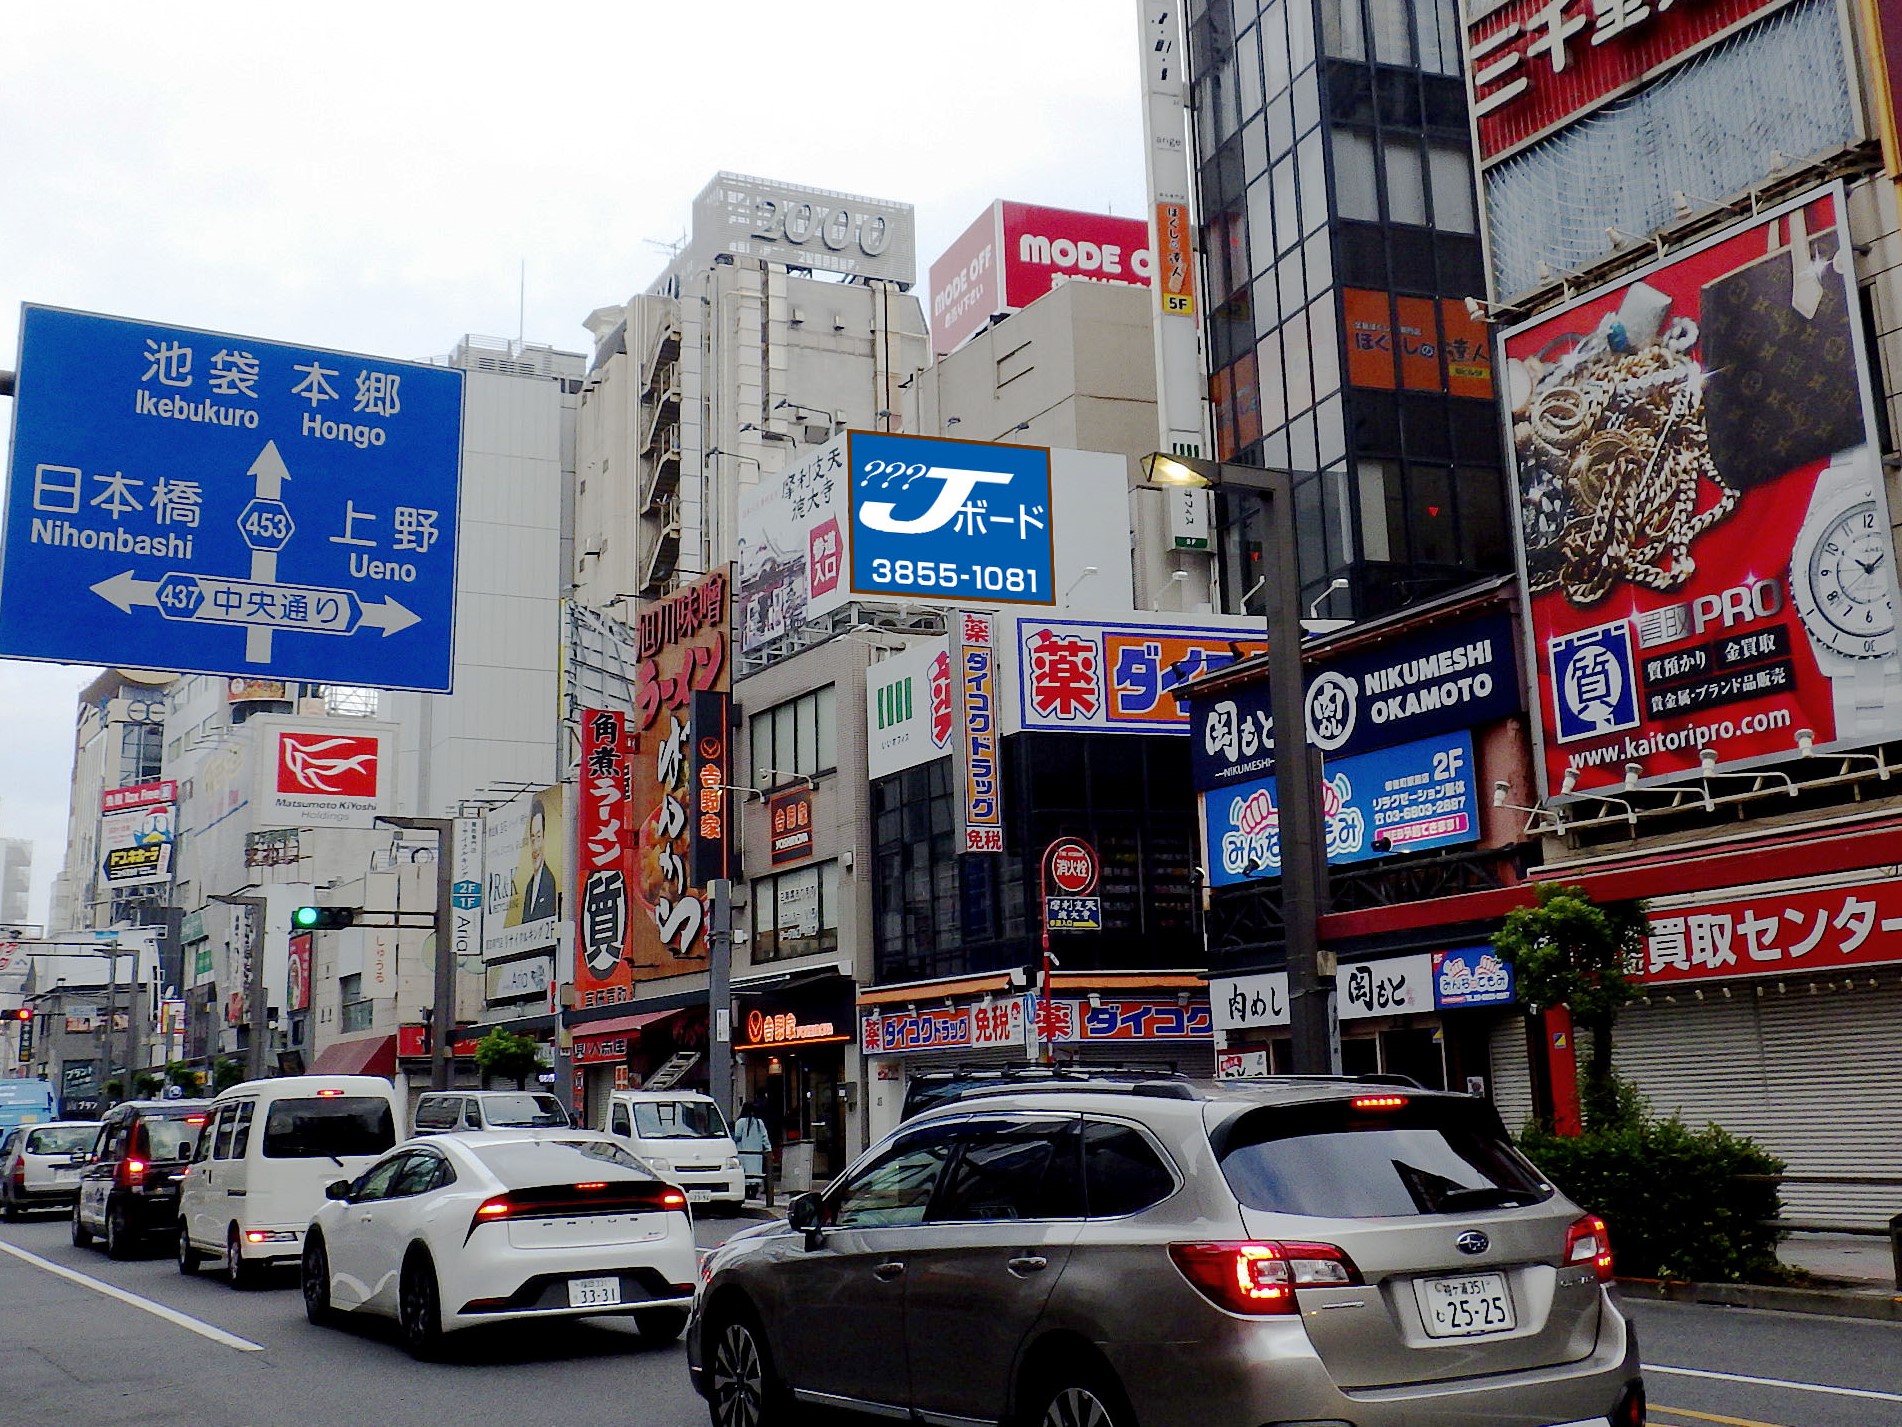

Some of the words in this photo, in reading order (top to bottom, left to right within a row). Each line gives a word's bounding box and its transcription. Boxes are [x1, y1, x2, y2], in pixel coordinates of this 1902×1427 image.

[751, 200, 894, 256] 2000
[1020, 234, 1121, 272] MODE
[935, 268, 968, 317] MODE
[970, 244, 992, 282] OFF
[1169, 297, 1187, 310] 5F
[141, 338, 260, 399] 池袋
[291, 361, 401, 418] 本郷
[135, 389, 260, 429] Ikebukuro
[302, 413, 386, 449] Hongo
[33, 463, 203, 528] 日本橋
[30, 518, 193, 560] Nihonbashi
[245, 512, 287, 540] 453
[329, 500, 439, 553] 上野
[349, 552, 417, 583] Ueno
[813, 556, 837, 588] 入口
[872, 558, 1038, 593] 3855-1081
[160, 584, 199, 610] 437
[213, 586, 341, 624] 中央通り
[638, 574, 726, 660] 旭川味噌
[964, 614, 990, 643] 薬
[1030, 632, 1098, 716] 薬
[1365, 640, 1493, 697] NIKUMESHI
[1647, 649, 1707, 682] 質預かり
[1724, 632, 1776, 664] 金買取
[636, 631, 724, 731] ラーメン
[1371, 673, 1494, 724] OKAMOTO
[1571, 647, 1623, 726] 質
[965, 651, 995, 819] ダイコクドラッグ
[1205, 701, 1275, 762] 岡もと
[1569, 707, 1791, 770] www.kaitoripro.com
[1433, 747, 1463, 780] 2F
[275, 798, 337, 810] Matsumoto
[339, 801, 377, 811] KiYoshi
[588, 711, 623, 866] 角煮ラーメン
[700, 763, 722, 839] 吉野家
[775, 800, 808, 833] 吉野家
[966, 829, 1002, 851] 免税
[459, 883, 476, 894] 2F
[1056, 859, 1088, 877] 消火栓
[459, 897, 476, 909] 1F
[583, 871, 627, 969] 質
[1622, 896, 1902, 976] 買取センター
[1228, 982, 1283, 1023] 肉めし
[1350, 965, 1406, 1012] 岡もと
[763, 1012, 797, 1042] 吉野家
[865, 1017, 879, 1049] 薬
[884, 1015, 969, 1047] ダイコクドラッグ
[974, 1004, 1011, 1043] 免税
[581, 1287, 615, 1304] 33-31
[1447, 1297, 1506, 1328] 25-25
